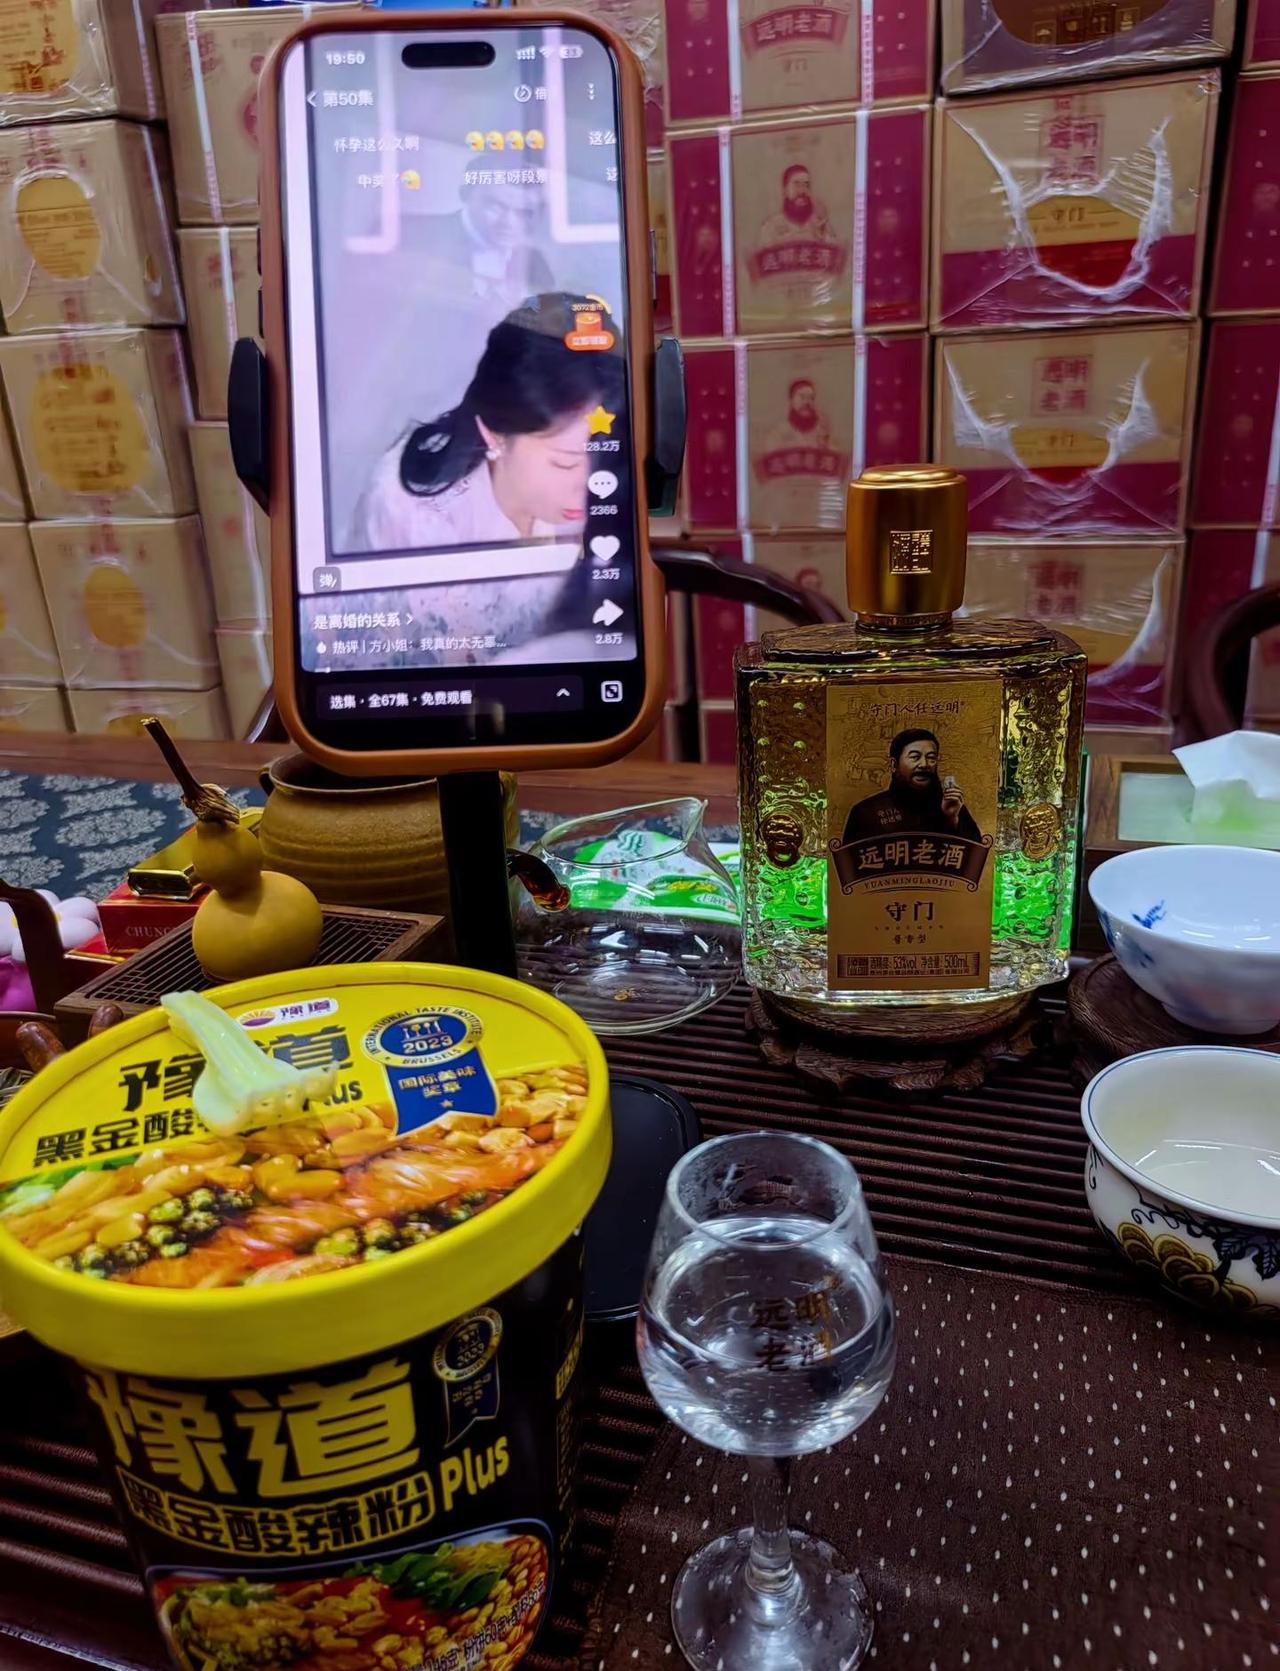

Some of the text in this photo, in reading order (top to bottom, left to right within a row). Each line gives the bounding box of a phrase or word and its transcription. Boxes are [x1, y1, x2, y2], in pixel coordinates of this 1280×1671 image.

[322, 89, 374, 107] 第50集
[592, 567, 620, 580] 2.3万
[313, 612, 401, 630] 是离婚的关系
[594, 632, 623, 645] 2.8万
[857, 841, 967, 871] 远明老酒
[885, 901, 935, 922] 守门
[402, 1034, 454, 1055] 2023
[401, 1047, 462, 1065] BRUSSELS
[398, 1066, 477, 1090] 国际美味
[422, 1081, 462, 1099] 奖章
[84, 1358, 421, 1499] 豫道
[440, 1435, 511, 1513] Plus
[119, 1470, 435, 1556] 黑金酸辣粉
